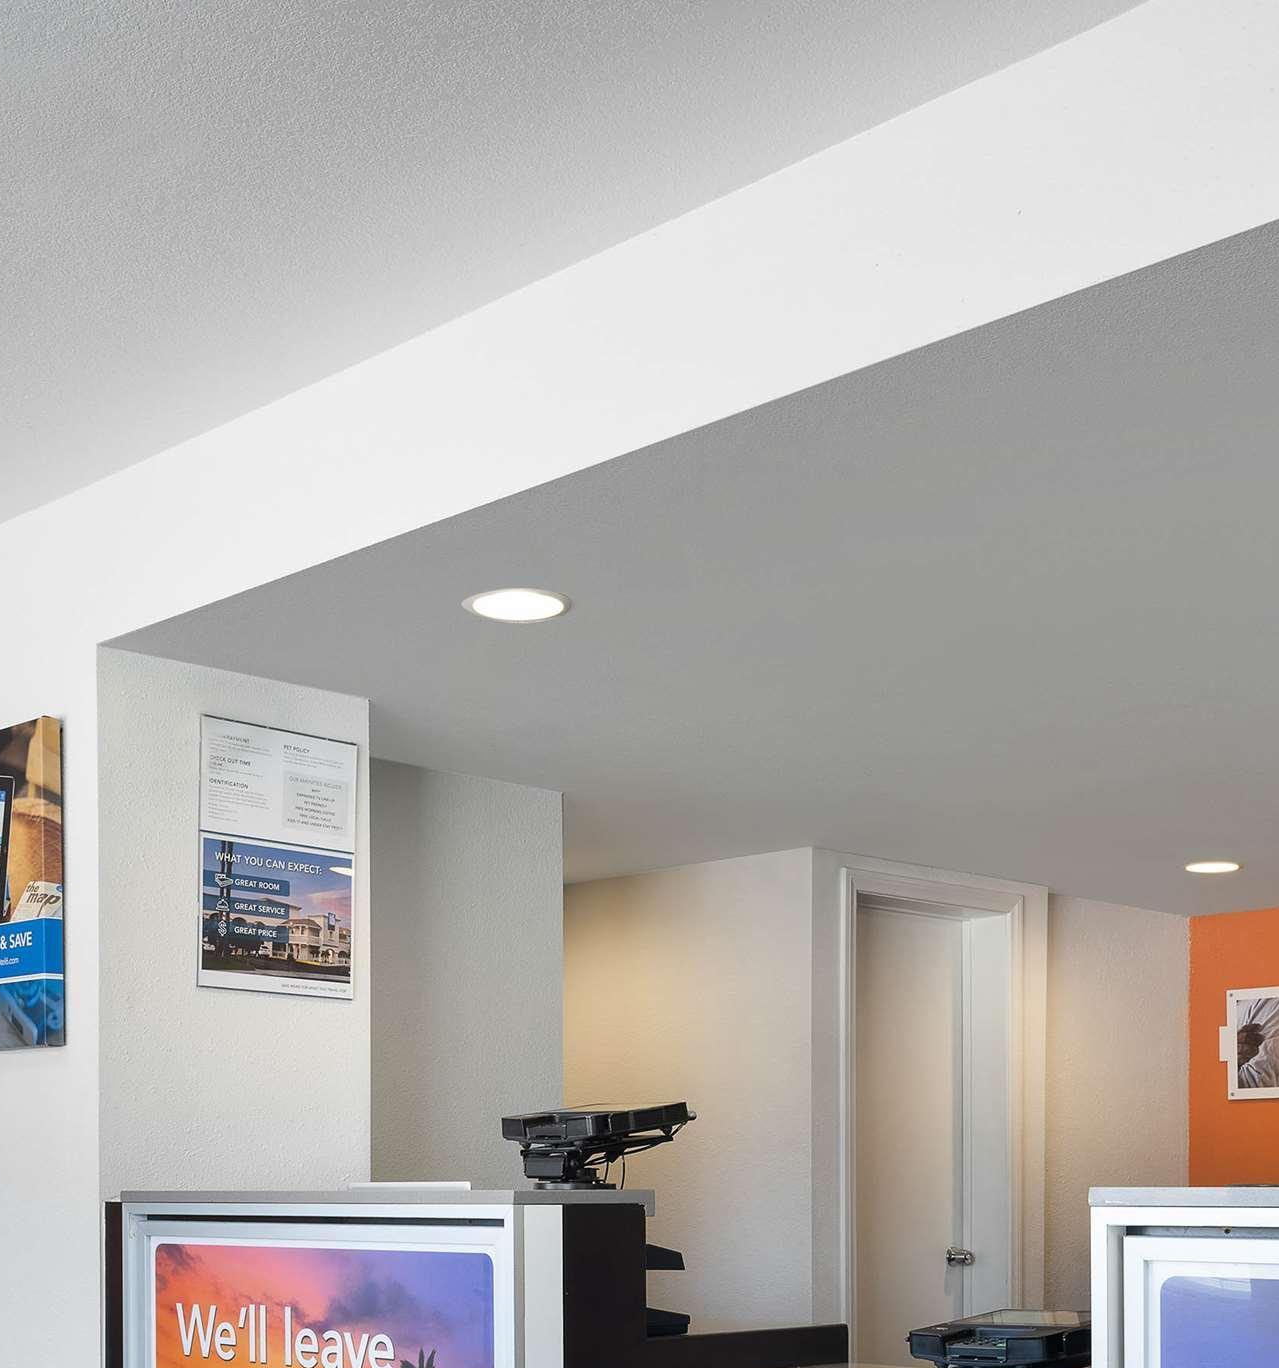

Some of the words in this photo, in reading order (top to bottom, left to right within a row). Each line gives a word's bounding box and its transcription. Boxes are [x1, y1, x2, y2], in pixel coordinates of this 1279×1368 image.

[214, 851, 242, 864] WHAT
[244, 856, 263, 867] YOU
[265, 859, 285, 870] CAN
[287, 863, 322, 875] EXPECT:
[26, 881, 40, 892] the
[234, 878, 257, 888] GREAT
[258, 881, 280, 891] ROOM
[26, 892, 61, 917] map
[234, 902, 257, 912] GREAT
[258, 905, 286, 915] SERVICE
[234, 926, 257, 936] GREAT
[258, 928, 278, 938] PRICE
[0, 935, 8, 950] &
[9, 931, 33, 949] SAVE
[176, 1302, 268, 1364] We'll
